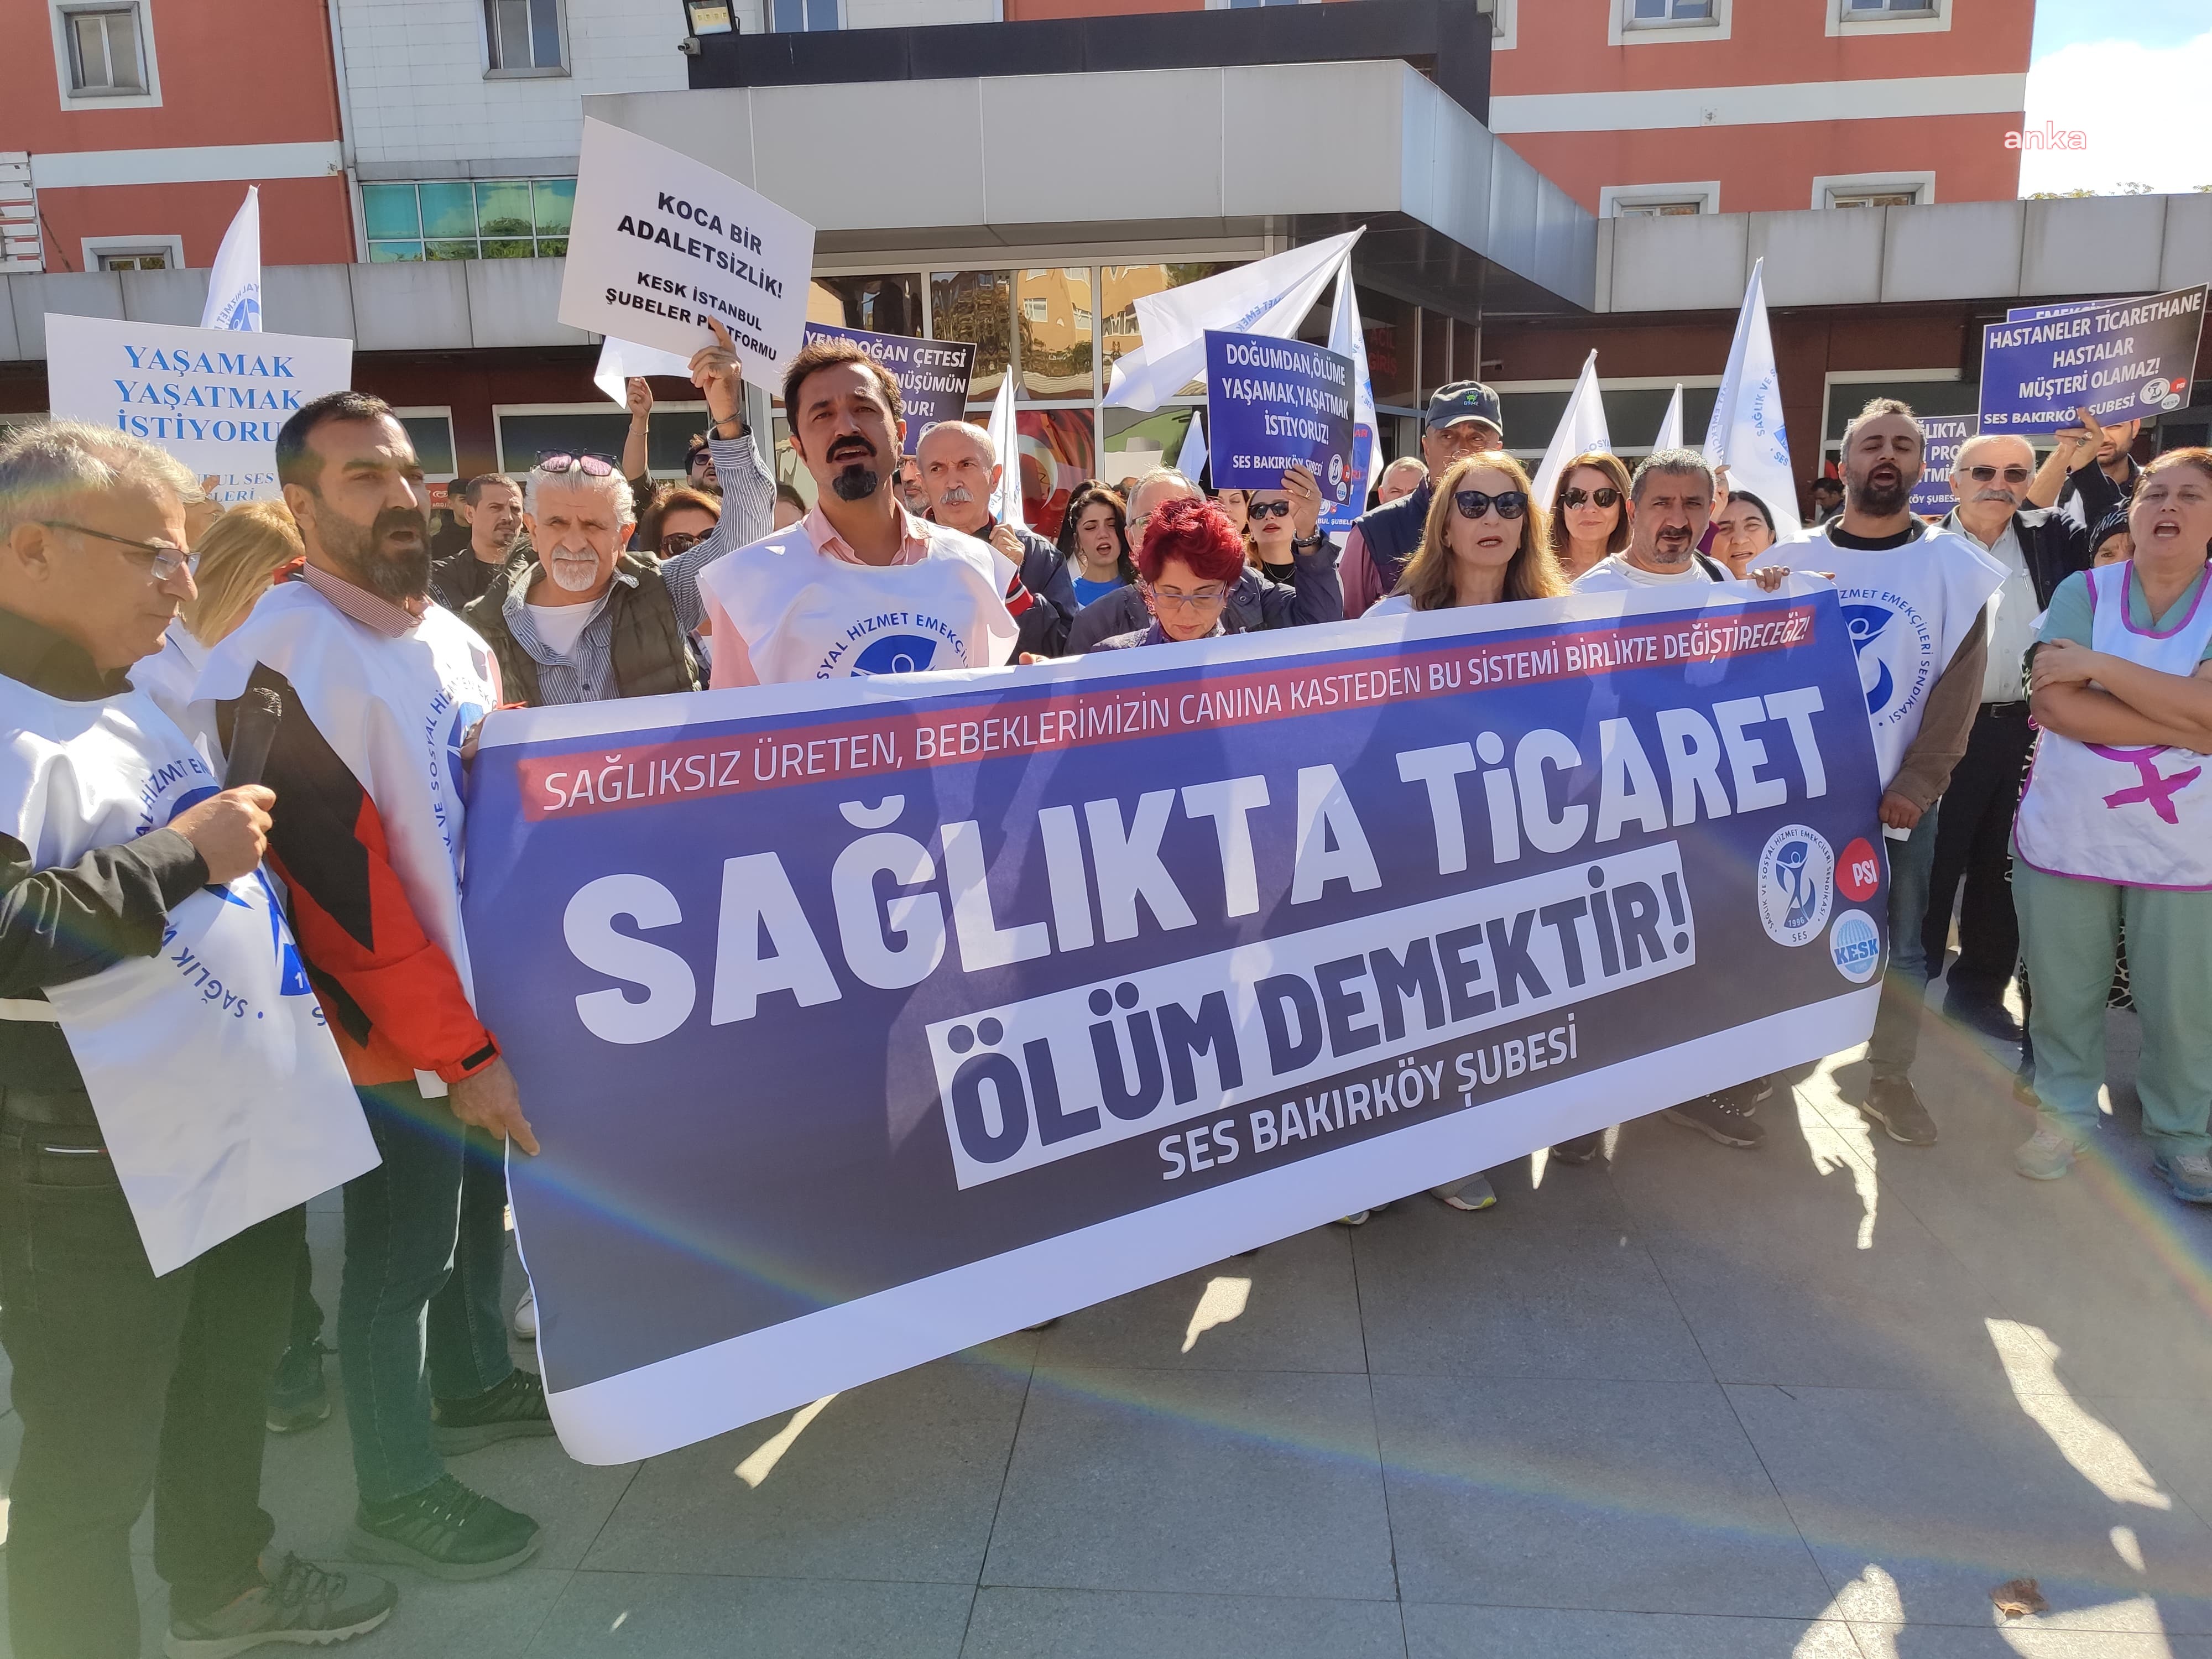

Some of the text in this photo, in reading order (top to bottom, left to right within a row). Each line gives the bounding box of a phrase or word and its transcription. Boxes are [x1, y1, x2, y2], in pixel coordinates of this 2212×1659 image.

[658, 192, 762, 255] KOCA BİR
[617, 215, 783, 299] ADALETSİZLİK!
[637, 272, 762, 331] KESK İSTANBUL
[606, 288, 777, 361] ŞUBELER PLTFORMU
[1990, 318, 2091, 349] HASTANELER
[2095, 292, 2202, 333] TİCARETHANE
[124, 345, 296, 378] YAŞAMAK
[913, 348, 967, 369] ÇETESİ
[2052, 337, 2135, 369] HASTALAR
[113, 379, 303, 411] YAŞATMAK
[889, 369, 966, 394] NÜŞÜMÜN
[2019, 357, 2161, 401] MÜŞTERİ OLAMAZ!
[900, 400, 935, 416] DUR!
[1984, 413, 2008, 424] SES
[2012, 406, 2080, 424] BAKIRKÖ
[117, 409, 280, 442] İSTİYORU
[1264, 409, 1329, 445] İSTİYORUZ!
[1233, 455, 1251, 468] SES
[1774, 451, 1788, 466] SES
[209, 488, 256, 503] LERİ
[244, 473, 274, 486] SES
[1927, 494, 1957, 505] ŞUBES
[816, 612, 969, 680] SYAL HİZMET EMEKÇİL
[1839, 589, 1934, 724] ZMET EMEKÇİLERİ SENDİKASI
[542, 612, 1811, 812] SAĞLIKSIZ ÜRETEN, BEBEKLERİMİZİN CANINA KASTEDEN BU SİSTEMİ BİRLİKTE DEĞİŞTİRECEĞİZ!
[139, 760, 188, 810] HİZMT
[1774, 829, 1798, 846] HİZMET
[1801, 830, 1832, 864] EMEKÇİLERİ
[562, 685, 1827, 1045] SAĞLIKTA TİCARET
[1762, 846, 1775, 880] SOSYAL
[1853, 859, 1877, 886] PSI
[1761, 884, 1766, 896] VE
[1819, 867, 1832, 916] SENDİKASI
[1788, 916, 1805, 927] 1996
[1792, 931, 1807, 942] SES
[1834, 938, 1879, 965] KESK
[170, 946, 248, 1018] SAĞLIK
[947, 865, 1691, 1164] ÖLÜM DEMEKTİR!
[1158, 1013, 1578, 1181] SES BAKIRKÖY ŞUBESİ
